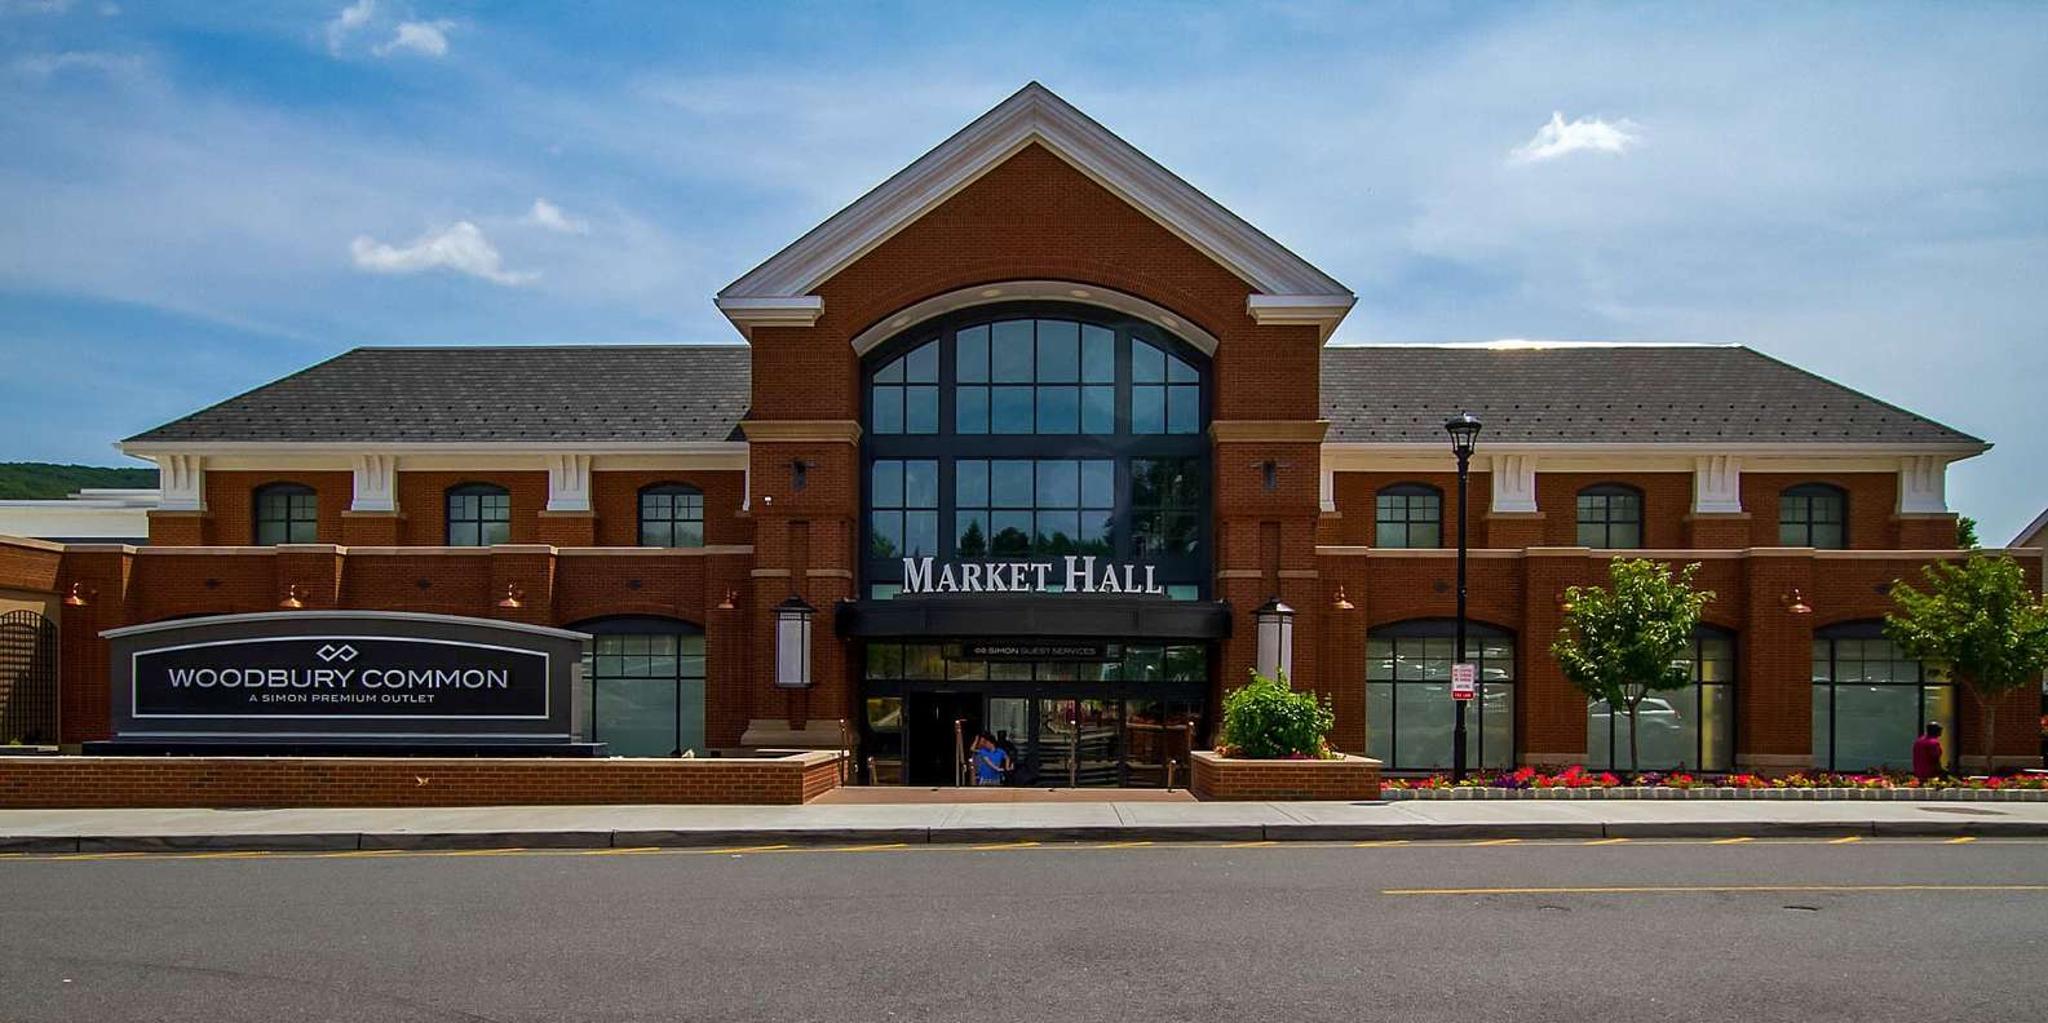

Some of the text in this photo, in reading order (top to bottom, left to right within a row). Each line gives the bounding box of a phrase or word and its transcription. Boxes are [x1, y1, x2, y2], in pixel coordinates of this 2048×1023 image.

[902, 555, 1163, 594] MARKET HALL
[988, 646, 1019, 655] SIMON
[168, 668, 508, 689] WOODBURY COMMON
[249, 694, 435, 703] A SIMON PREMIUM OUTLET
